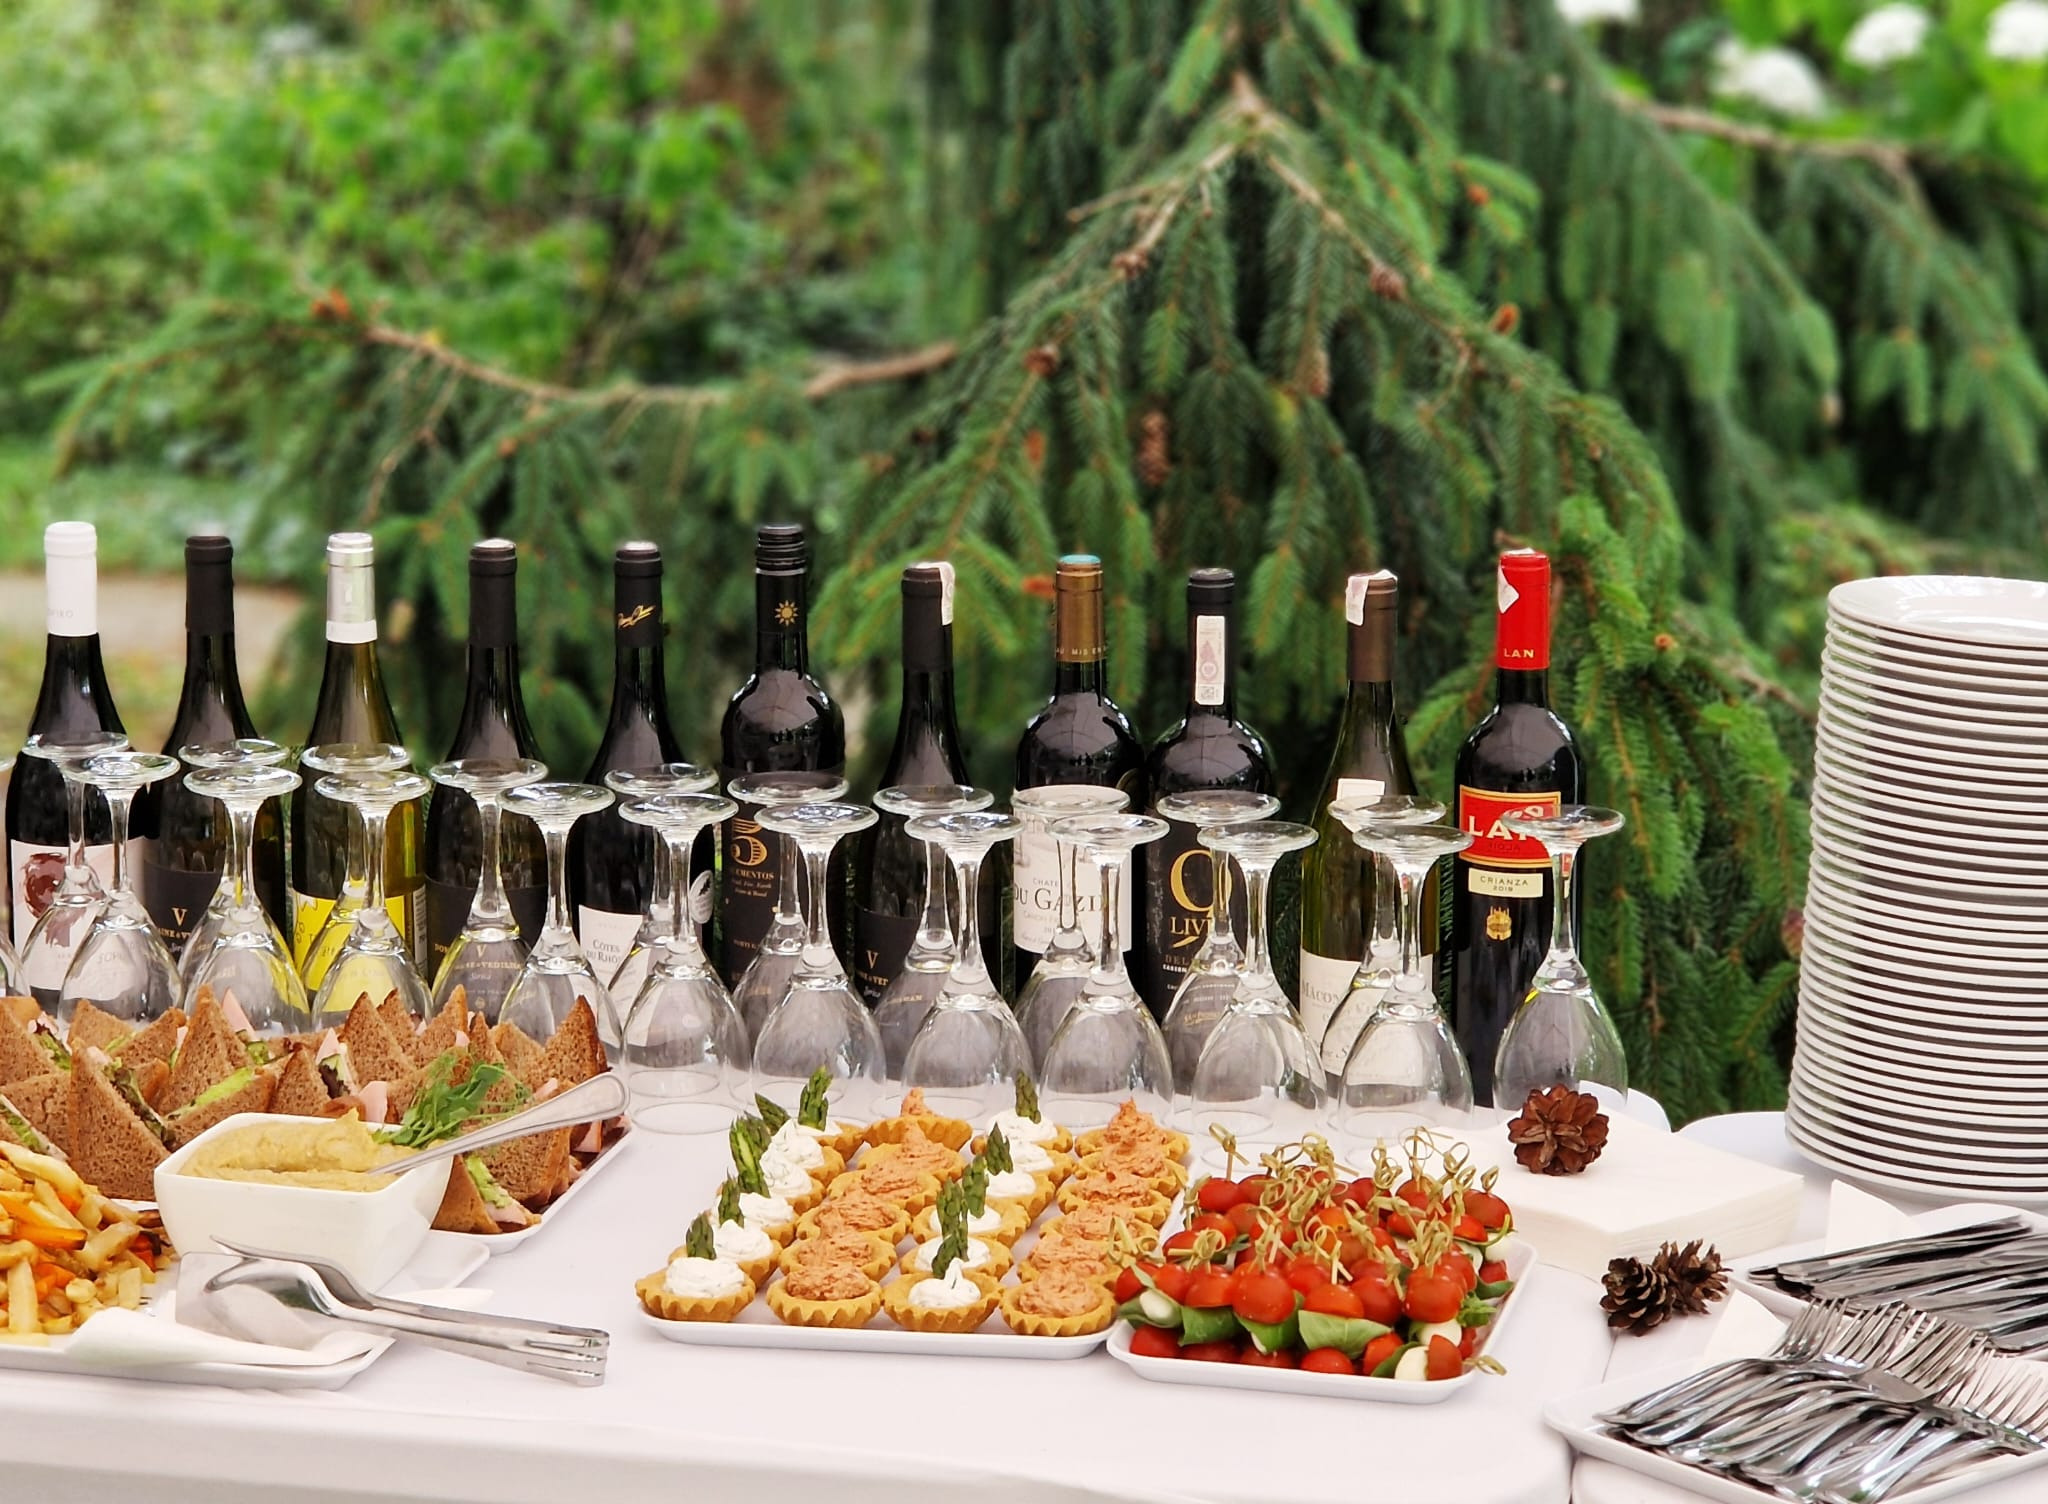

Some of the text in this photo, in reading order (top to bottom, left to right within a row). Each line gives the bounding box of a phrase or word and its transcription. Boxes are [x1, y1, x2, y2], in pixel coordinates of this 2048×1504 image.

[1503, 648, 1534, 658] LAN
[1480, 875, 1528, 887] CRIANZA
[171, 907, 188, 927] V
[867, 950, 879, 969] V
